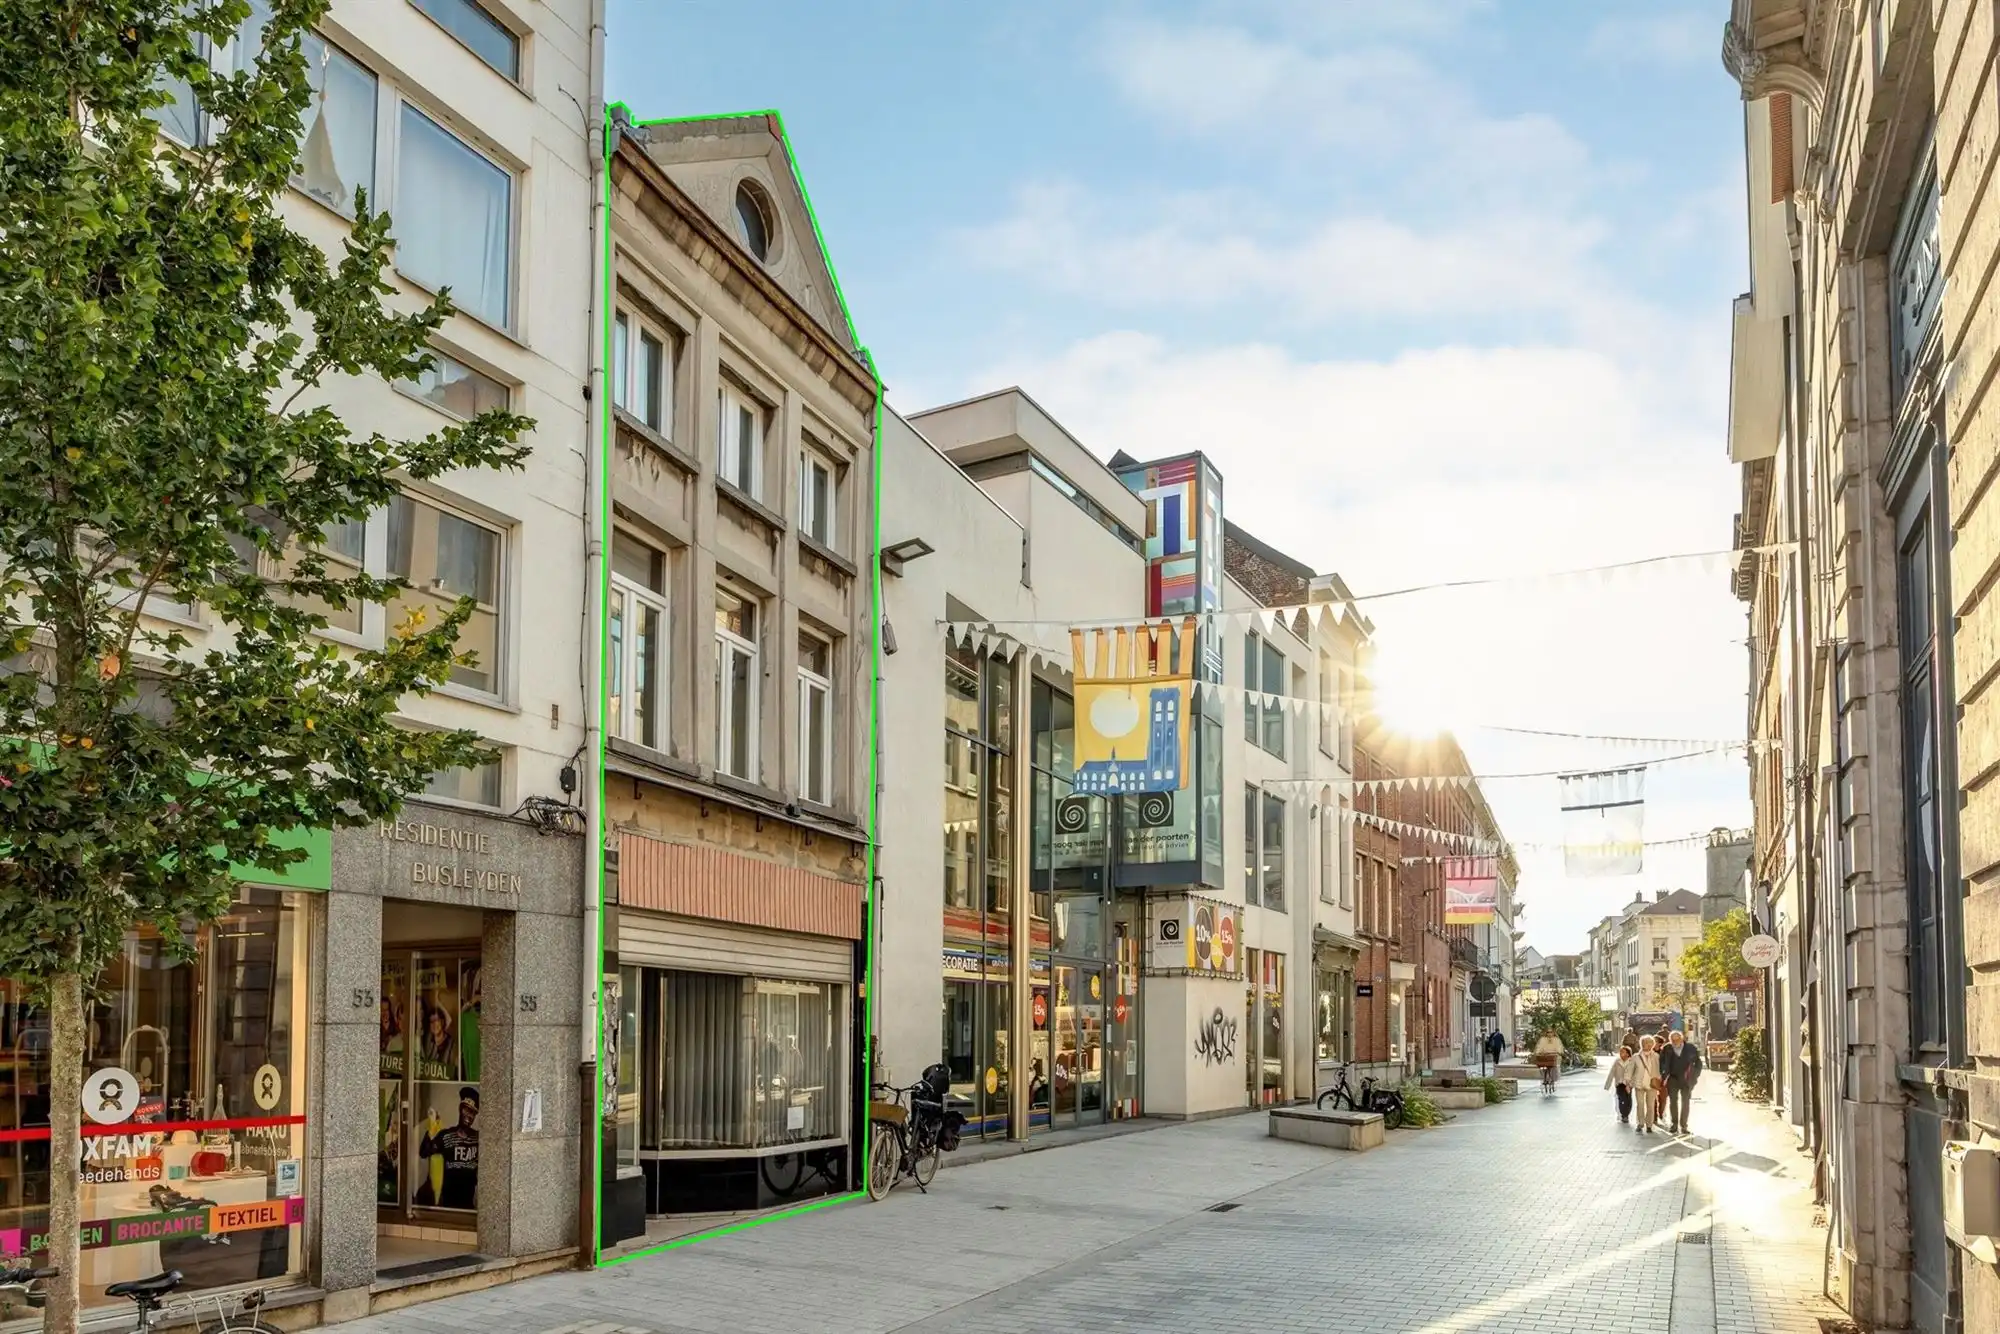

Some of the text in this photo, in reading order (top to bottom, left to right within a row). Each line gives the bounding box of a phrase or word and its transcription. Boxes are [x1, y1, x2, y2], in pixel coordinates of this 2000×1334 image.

[380, 819, 489, 854] RESIDENTIE
[1140, 833, 1154, 843] der
[1156, 833, 1189, 843] poorten
[413, 861, 521, 895] BUSLEYDEN
[1196, 924, 1212, 943] 10%
[1221, 929, 1233, 945] 15%
[352, 987, 374, 1008] 53
[520, 994, 538, 1012] 55
[420, 1060, 450, 1080] EQUAL
[80, 1133, 152, 1161] XFAM
[454, 1146, 477, 1161] FEAR
[117, 1214, 204, 1241] BROCANTE
[218, 1207, 278, 1228] TEXTIEL
